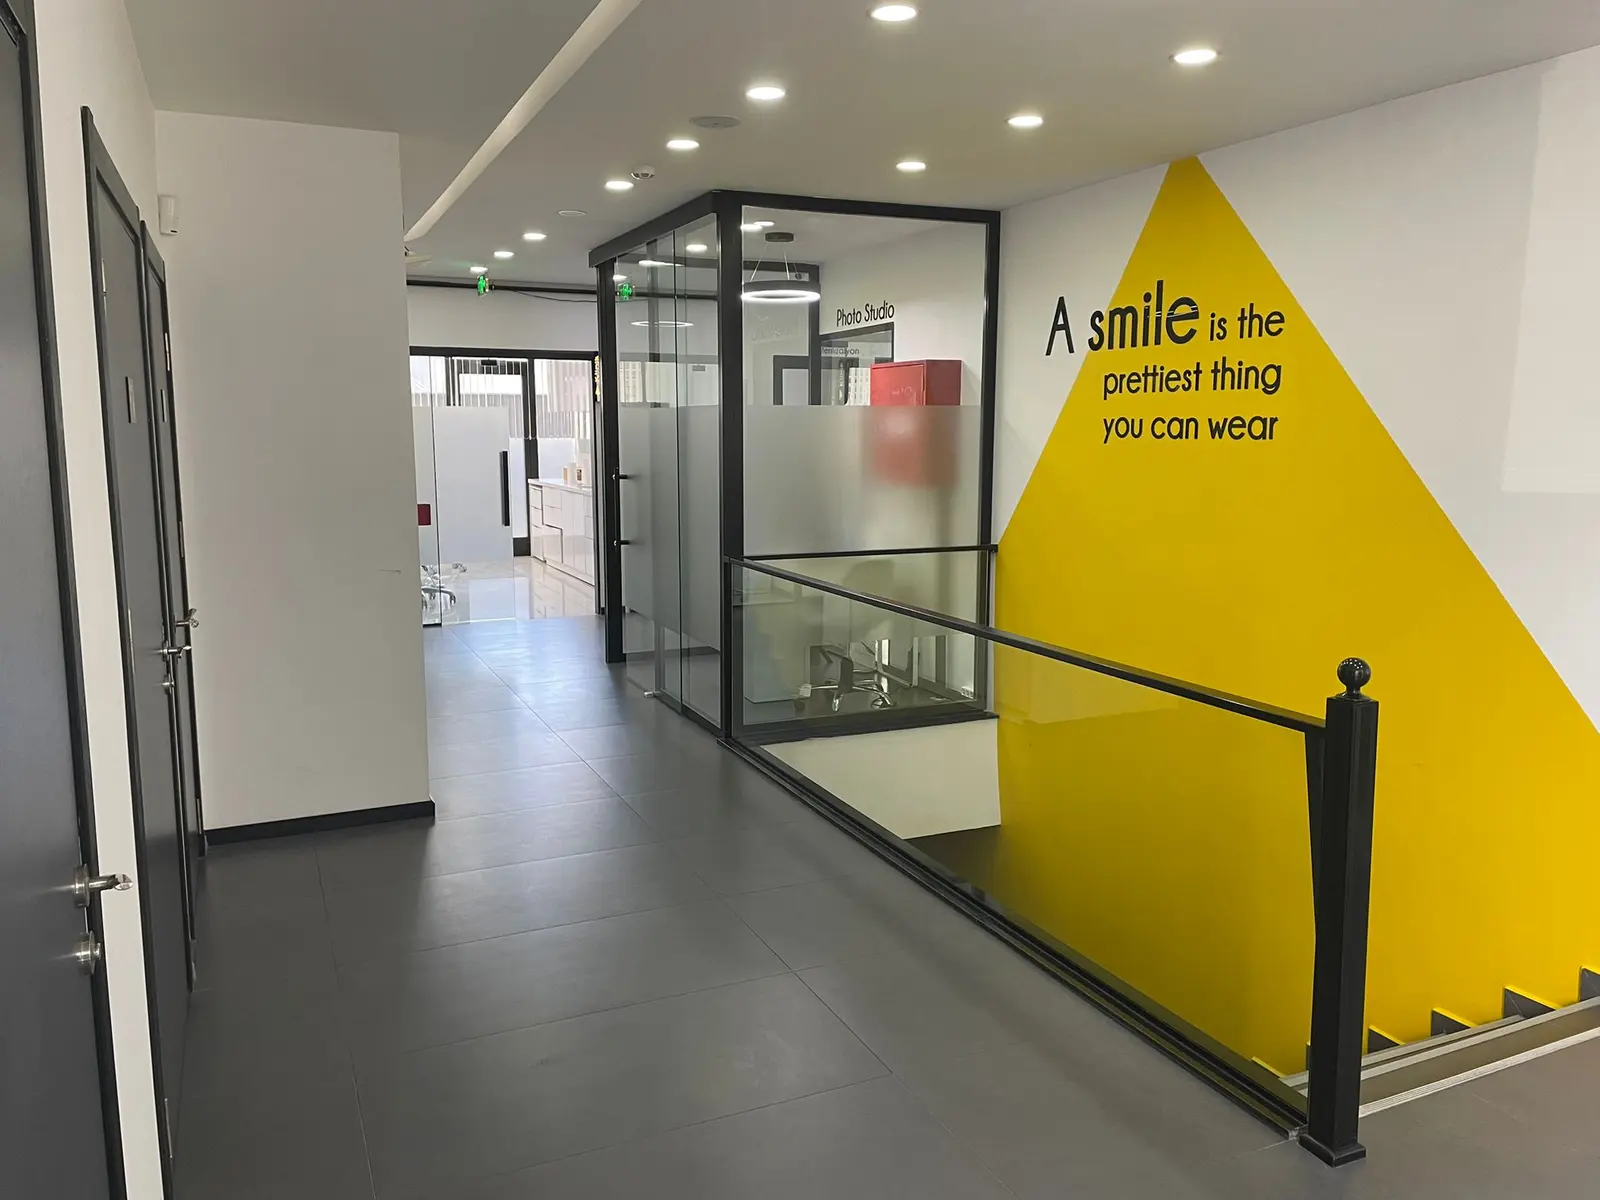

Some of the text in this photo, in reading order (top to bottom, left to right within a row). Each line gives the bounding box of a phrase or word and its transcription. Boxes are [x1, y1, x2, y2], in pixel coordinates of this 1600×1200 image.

[836, 300, 895, 327] Photo Studio
[1045, 279, 1285, 356] A smile is the
[1103, 356, 1282, 401] prettiest thing
[1103, 415, 1279, 444] you can wear
